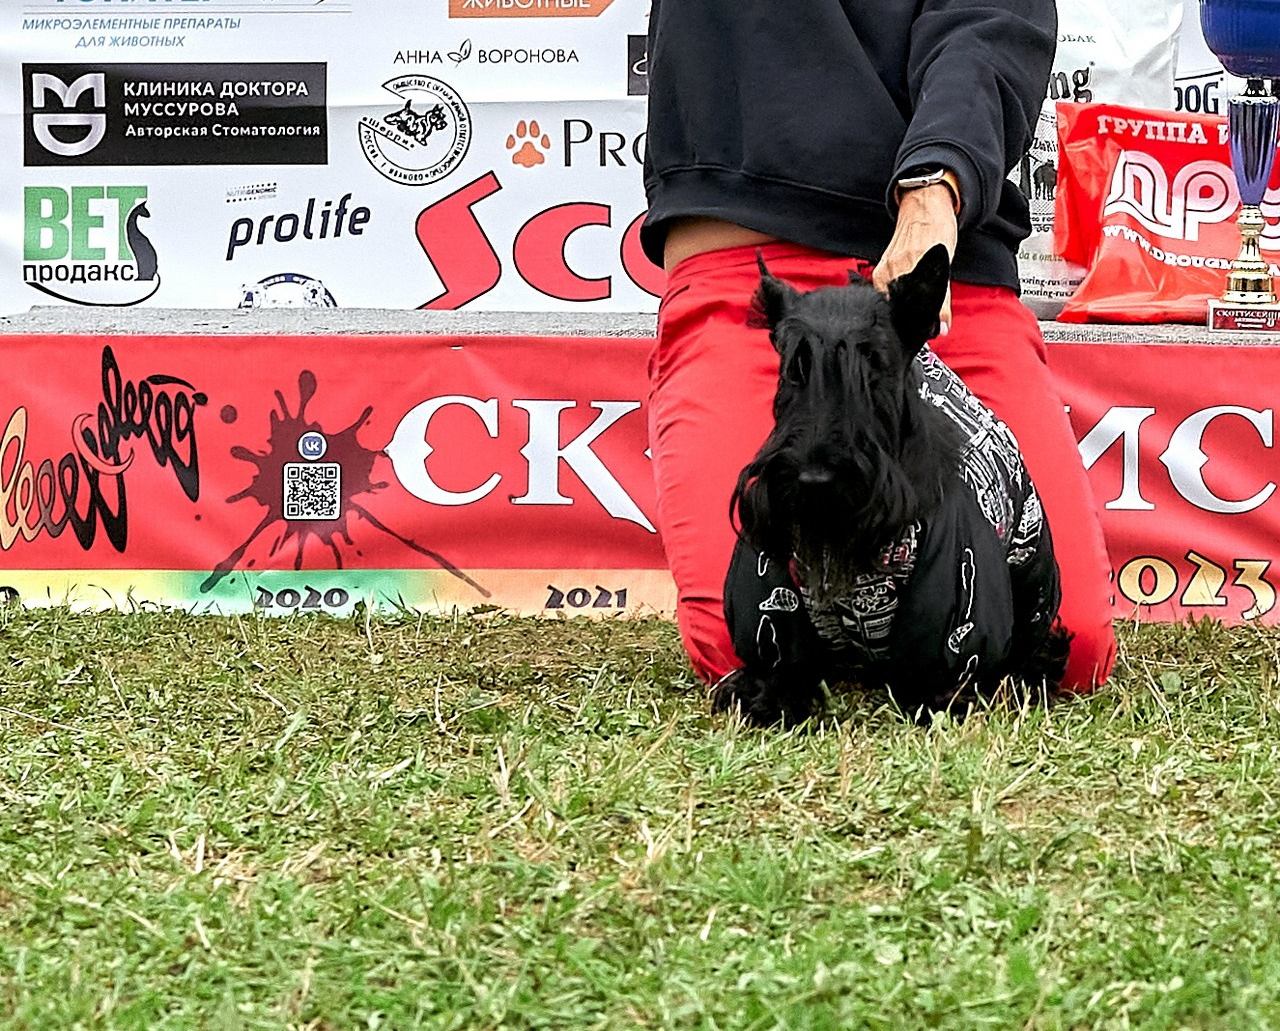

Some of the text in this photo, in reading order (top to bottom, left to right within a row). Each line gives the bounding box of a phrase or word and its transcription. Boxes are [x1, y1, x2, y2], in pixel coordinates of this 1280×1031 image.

[22, 17, 241, 31] МИКРОЭЛЕМЕНТНЫЕ ПРЕПАРАТЫ
[75, 35, 184, 48] ДЛЯ ЖИВОТНЫХ
[393, 49, 579, 64] АННА ВОРОНОВА
[124, 81, 309, 99] КЛИНИКА ДОКТОРА
[124, 102, 240, 117] МУССУРОВА
[125, 123, 321, 139] Авторская Стоматология
[1097, 115, 1208, 145] ГРУППА
[24, 186, 148, 262] ВЕТ
[226, 193, 371, 261] prolife
[23, 263, 136, 286] продакс
[256, 585, 348, 609] 2020
[544, 585, 627, 609] 2021
